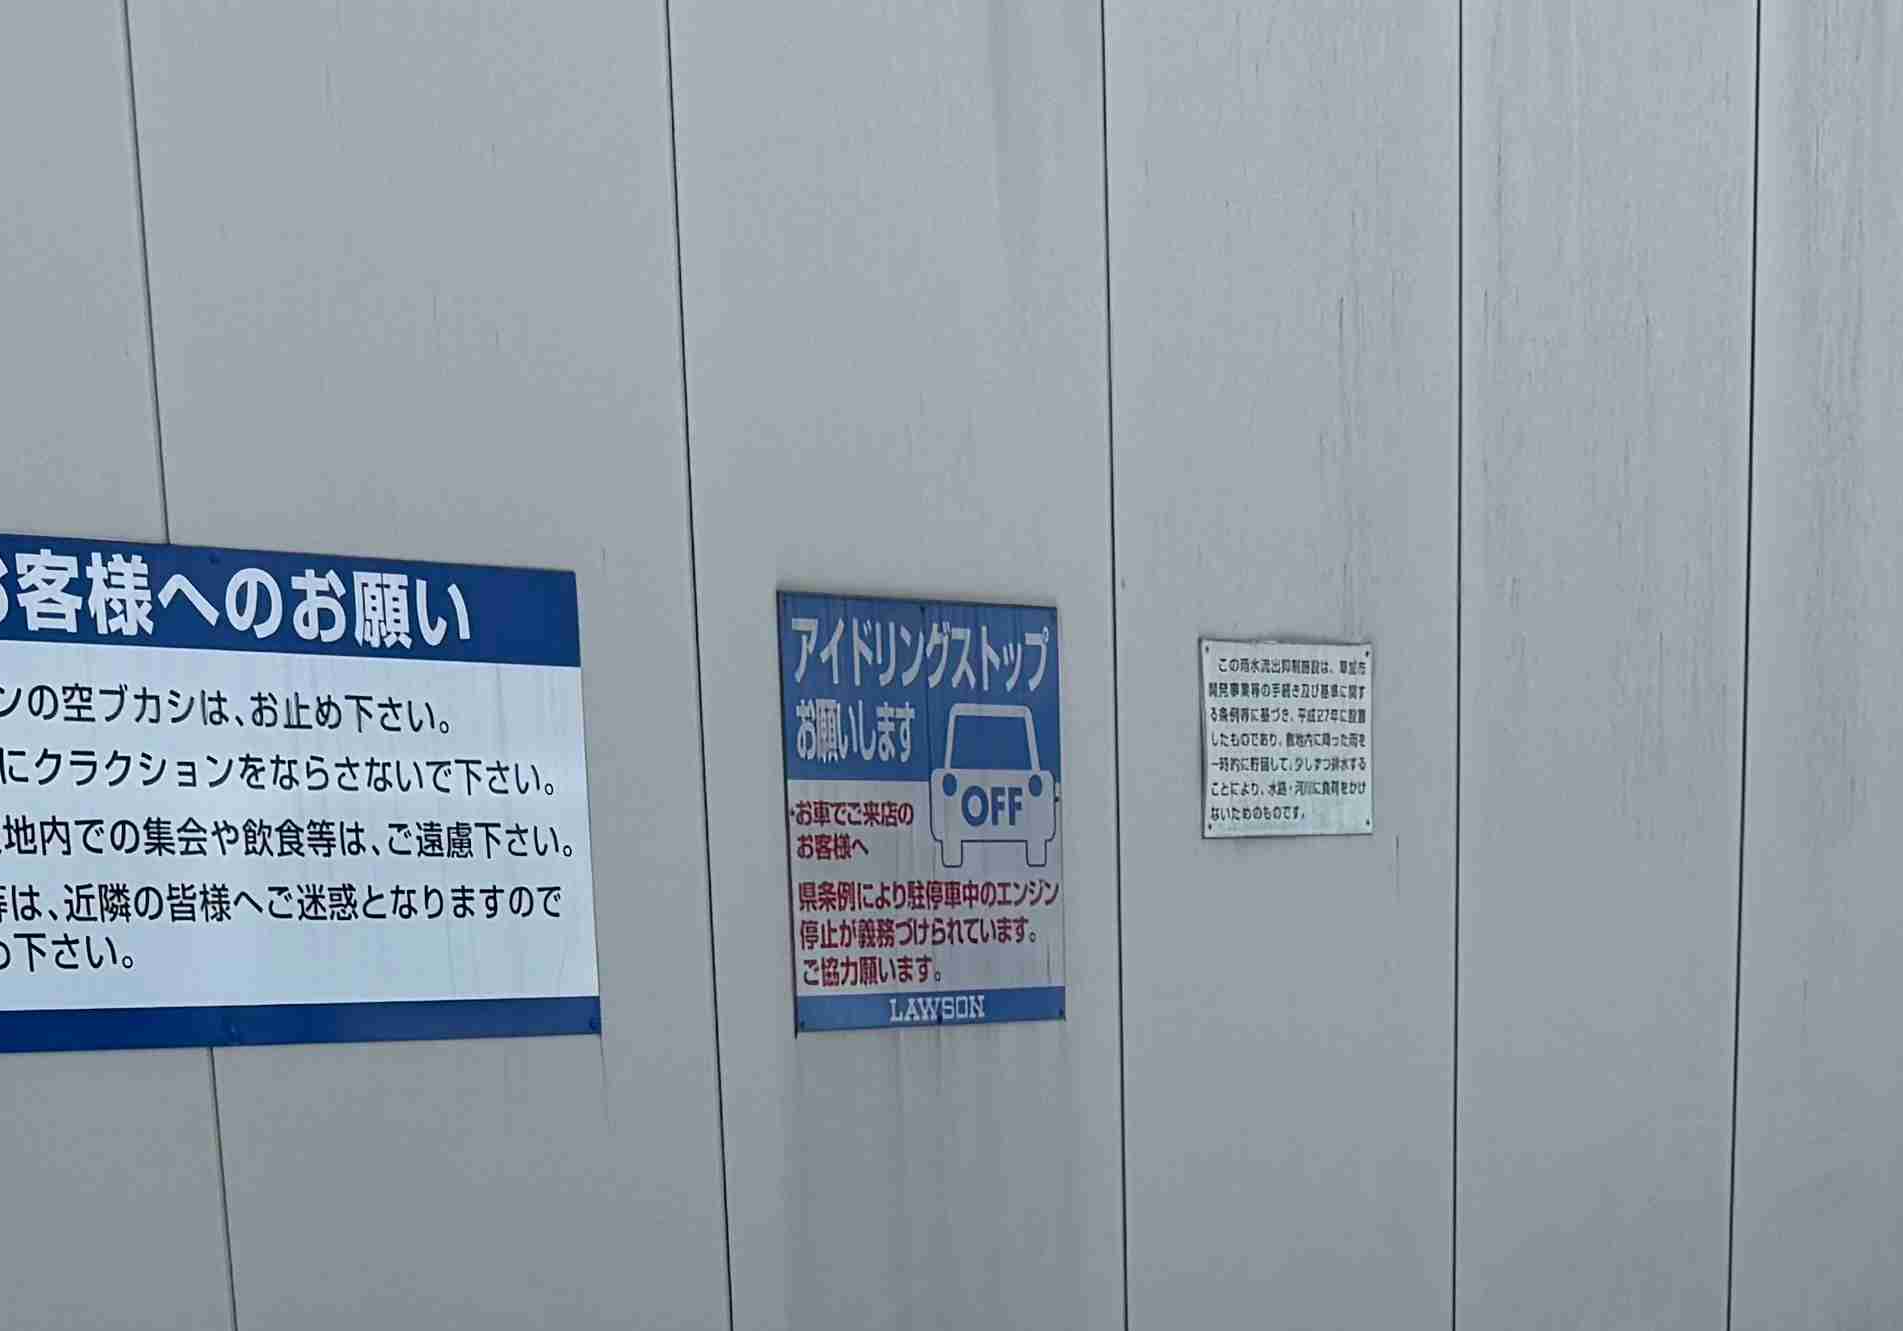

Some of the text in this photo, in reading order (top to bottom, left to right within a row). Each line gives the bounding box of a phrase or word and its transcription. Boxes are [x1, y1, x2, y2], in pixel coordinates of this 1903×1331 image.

[791, 617, 1051, 693] アイドリングストップ
[796, 700, 916, 764] お願いします
[795, 800, 914, 827] お車でご来店の
[961, 786, 1024, 828] OFF
[796, 834, 869, 861] お客様へ
[798, 880, 1060, 912] 県条例により駐停車中のエンジン
[800, 917, 1037, 951] 停止が義務づけられています。
[802, 956, 942, 987] ご協力願います。
[888, 995, 985, 1024] LAWSON
